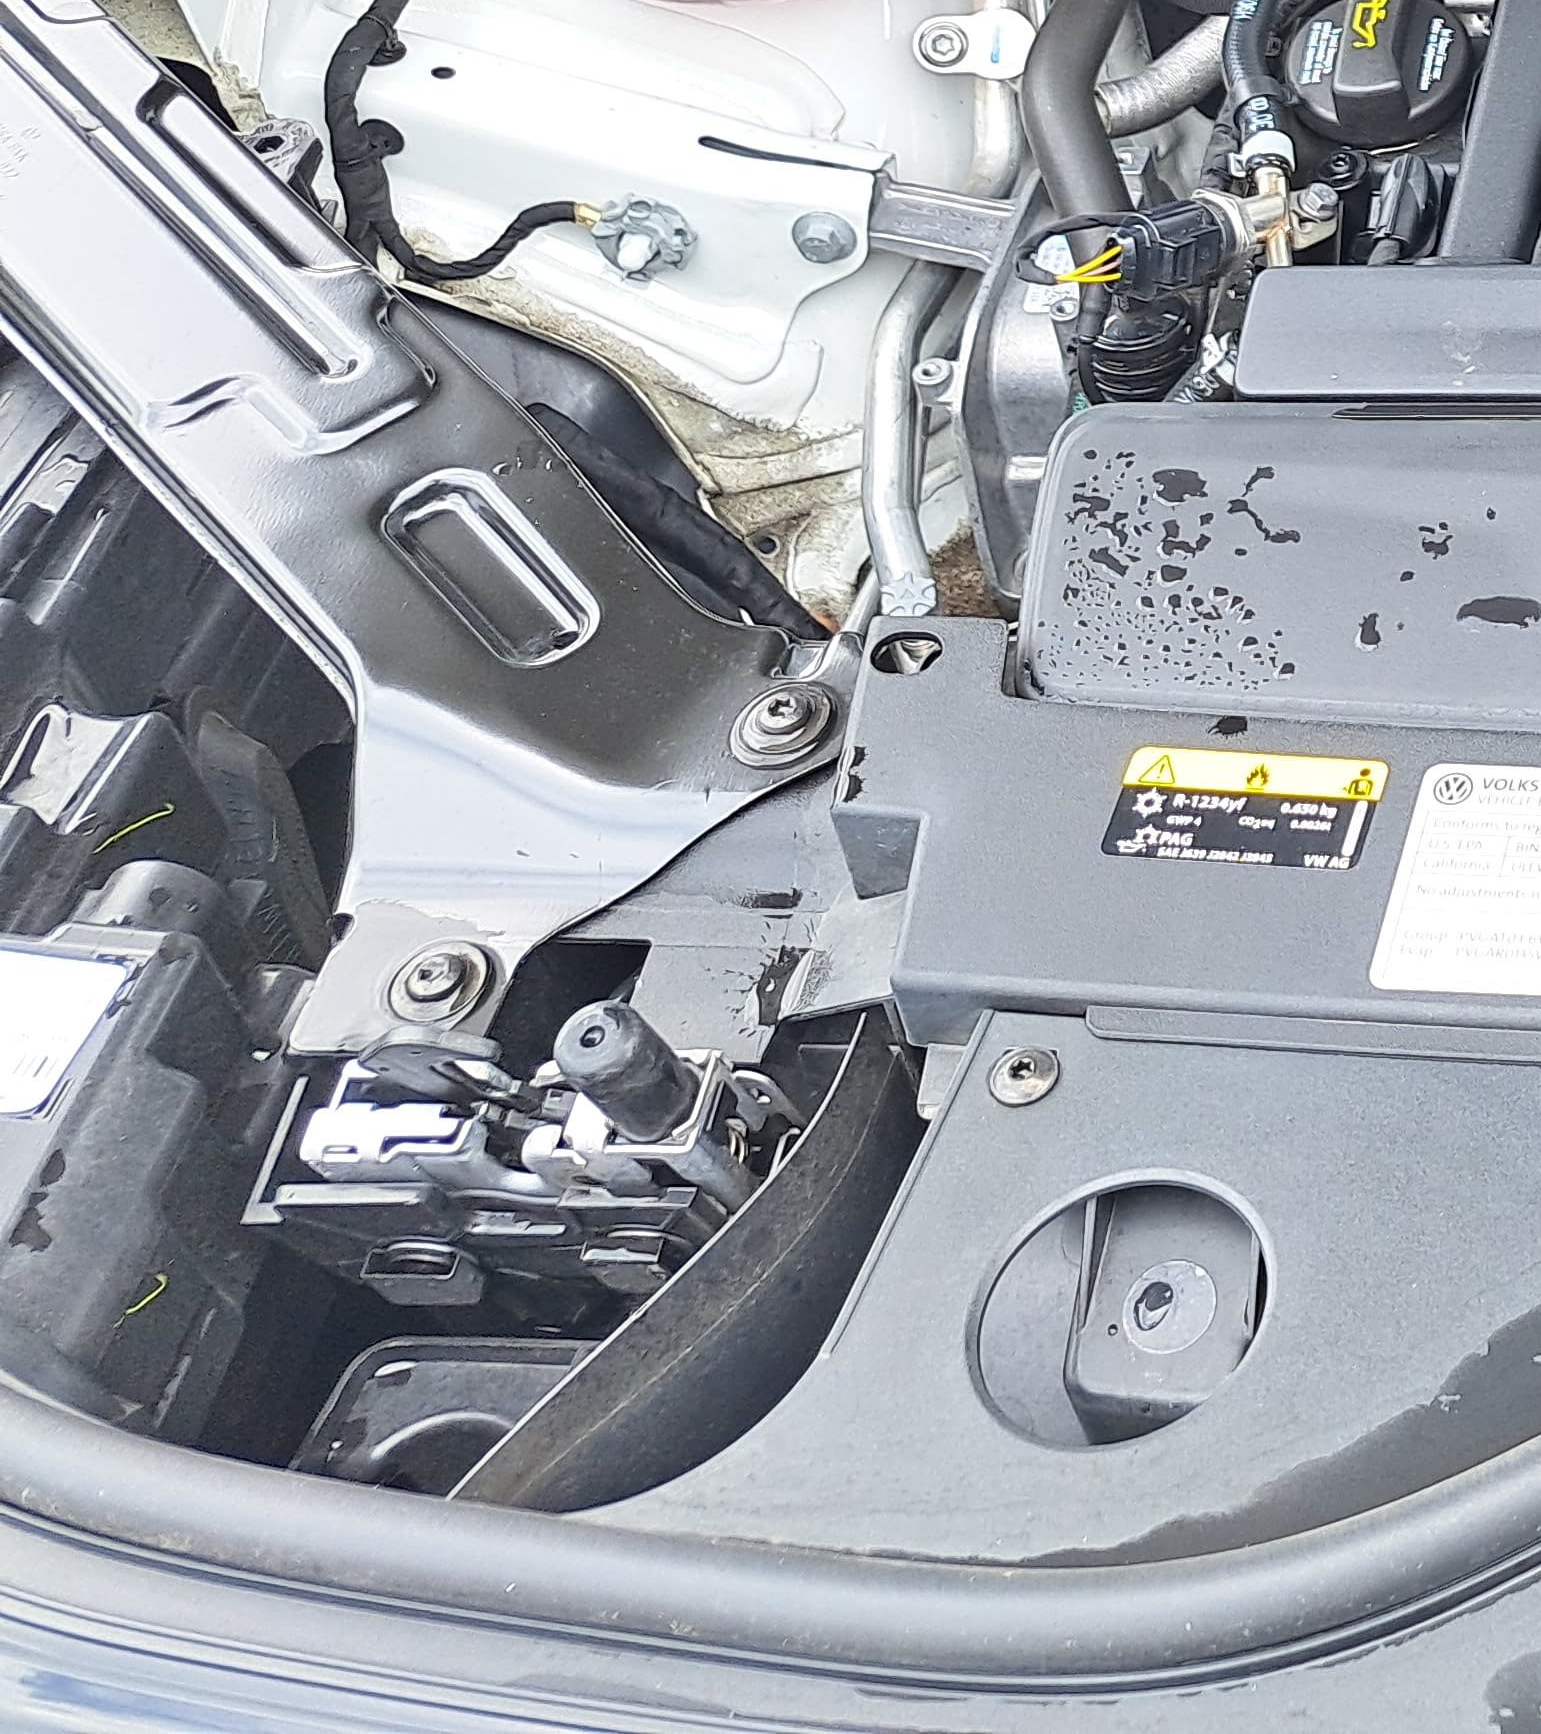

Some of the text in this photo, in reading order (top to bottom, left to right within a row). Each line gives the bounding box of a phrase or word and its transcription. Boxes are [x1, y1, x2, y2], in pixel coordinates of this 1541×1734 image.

[1172, 796, 1248, 813] R-1234yf
[1478, 794, 1532, 805] VEHICLE
[1166, 816, 1191, 826] GWP
[1432, 818, 1500, 830] Conforms
[1504, 820, 1519, 831] to
[1159, 832, 1195, 846] PAG
[1156, 847, 1178, 858] SAE
[1303, 854, 1350, 869] VW AG
[1416, 884, 1436, 896] No
[1439, 886, 1526, 899] adjustments
